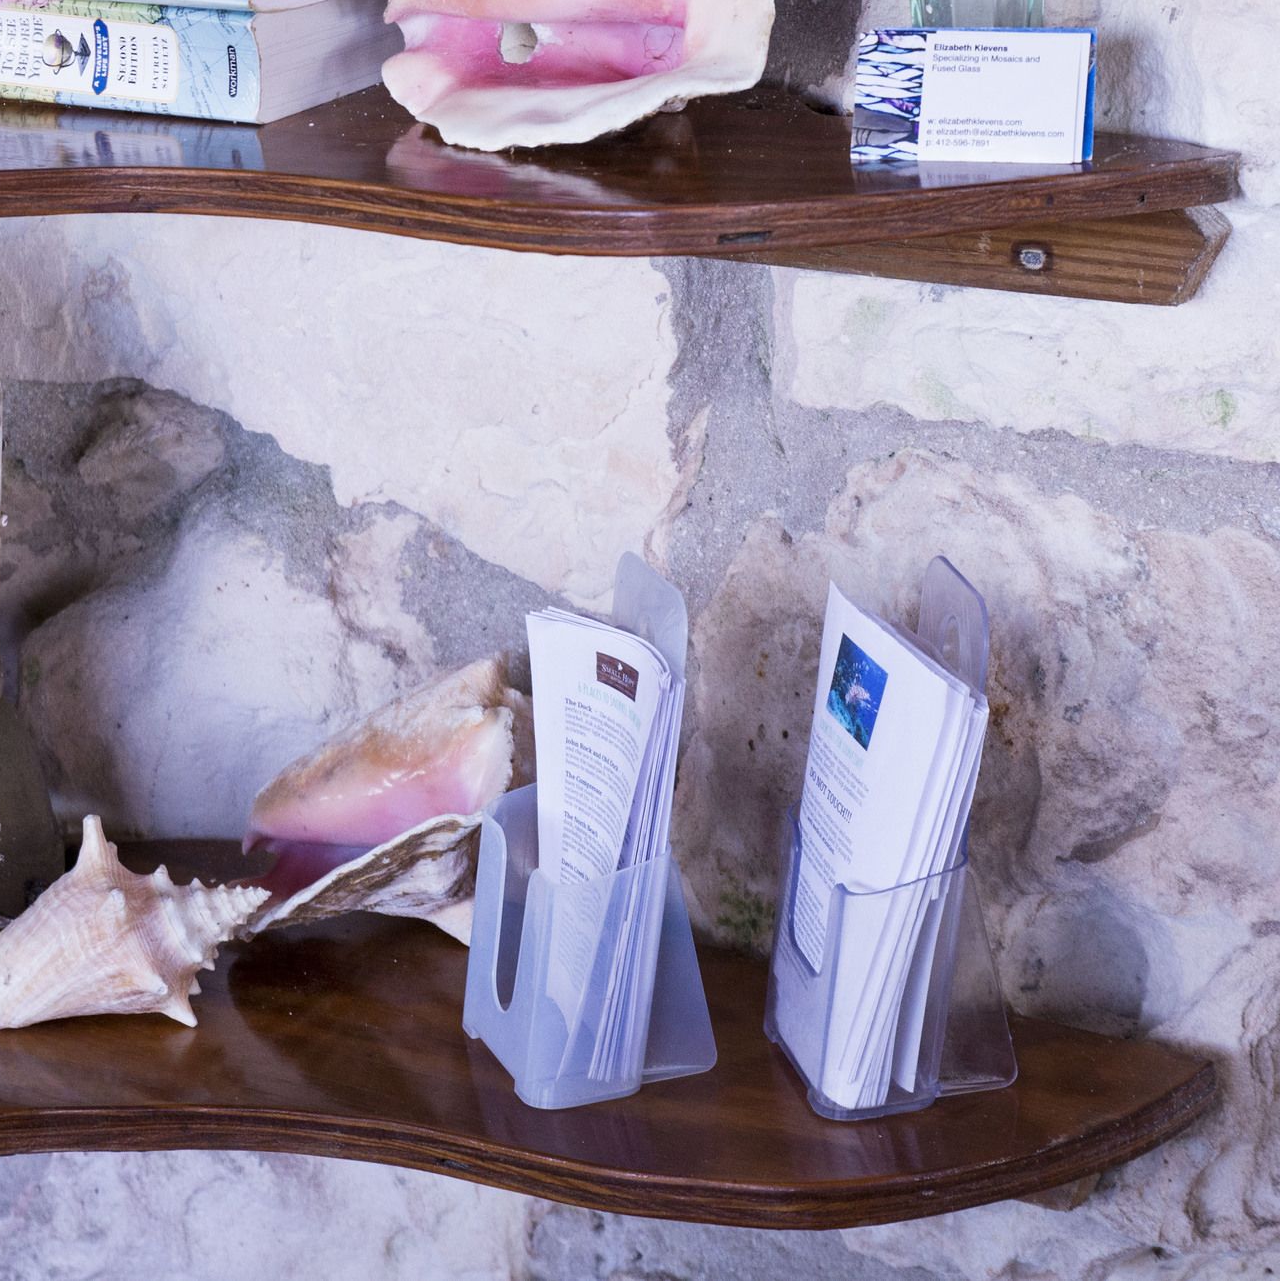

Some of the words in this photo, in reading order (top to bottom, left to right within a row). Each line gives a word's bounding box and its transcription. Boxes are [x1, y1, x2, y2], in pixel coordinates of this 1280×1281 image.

[33, 17, 43, 43] DIE
[15, 18, 30, 76] BEFORE
[118, 36, 126, 82] SECOND
[128, 36, 137, 84] EDITION
[933, 54, 979, 63] Specializing
[991, 55, 1023, 63] Mosaics
[1025, 55, 1040, 63] and
[1, 52, 14, 73] TO
[28, 51, 42, 78] YOU
[229, 47, 237, 96] workman
[958, 65, 981, 73] Glass
[936, 129, 1064, 137] elizabeth@elizabethklevens.com
[938, 118, 1022, 126] elizabethklevens.com
[809, 767, 817, 781] DO
[816, 776, 826, 794] NOT
[827, 789, 852, 824] TOUCH!!!
